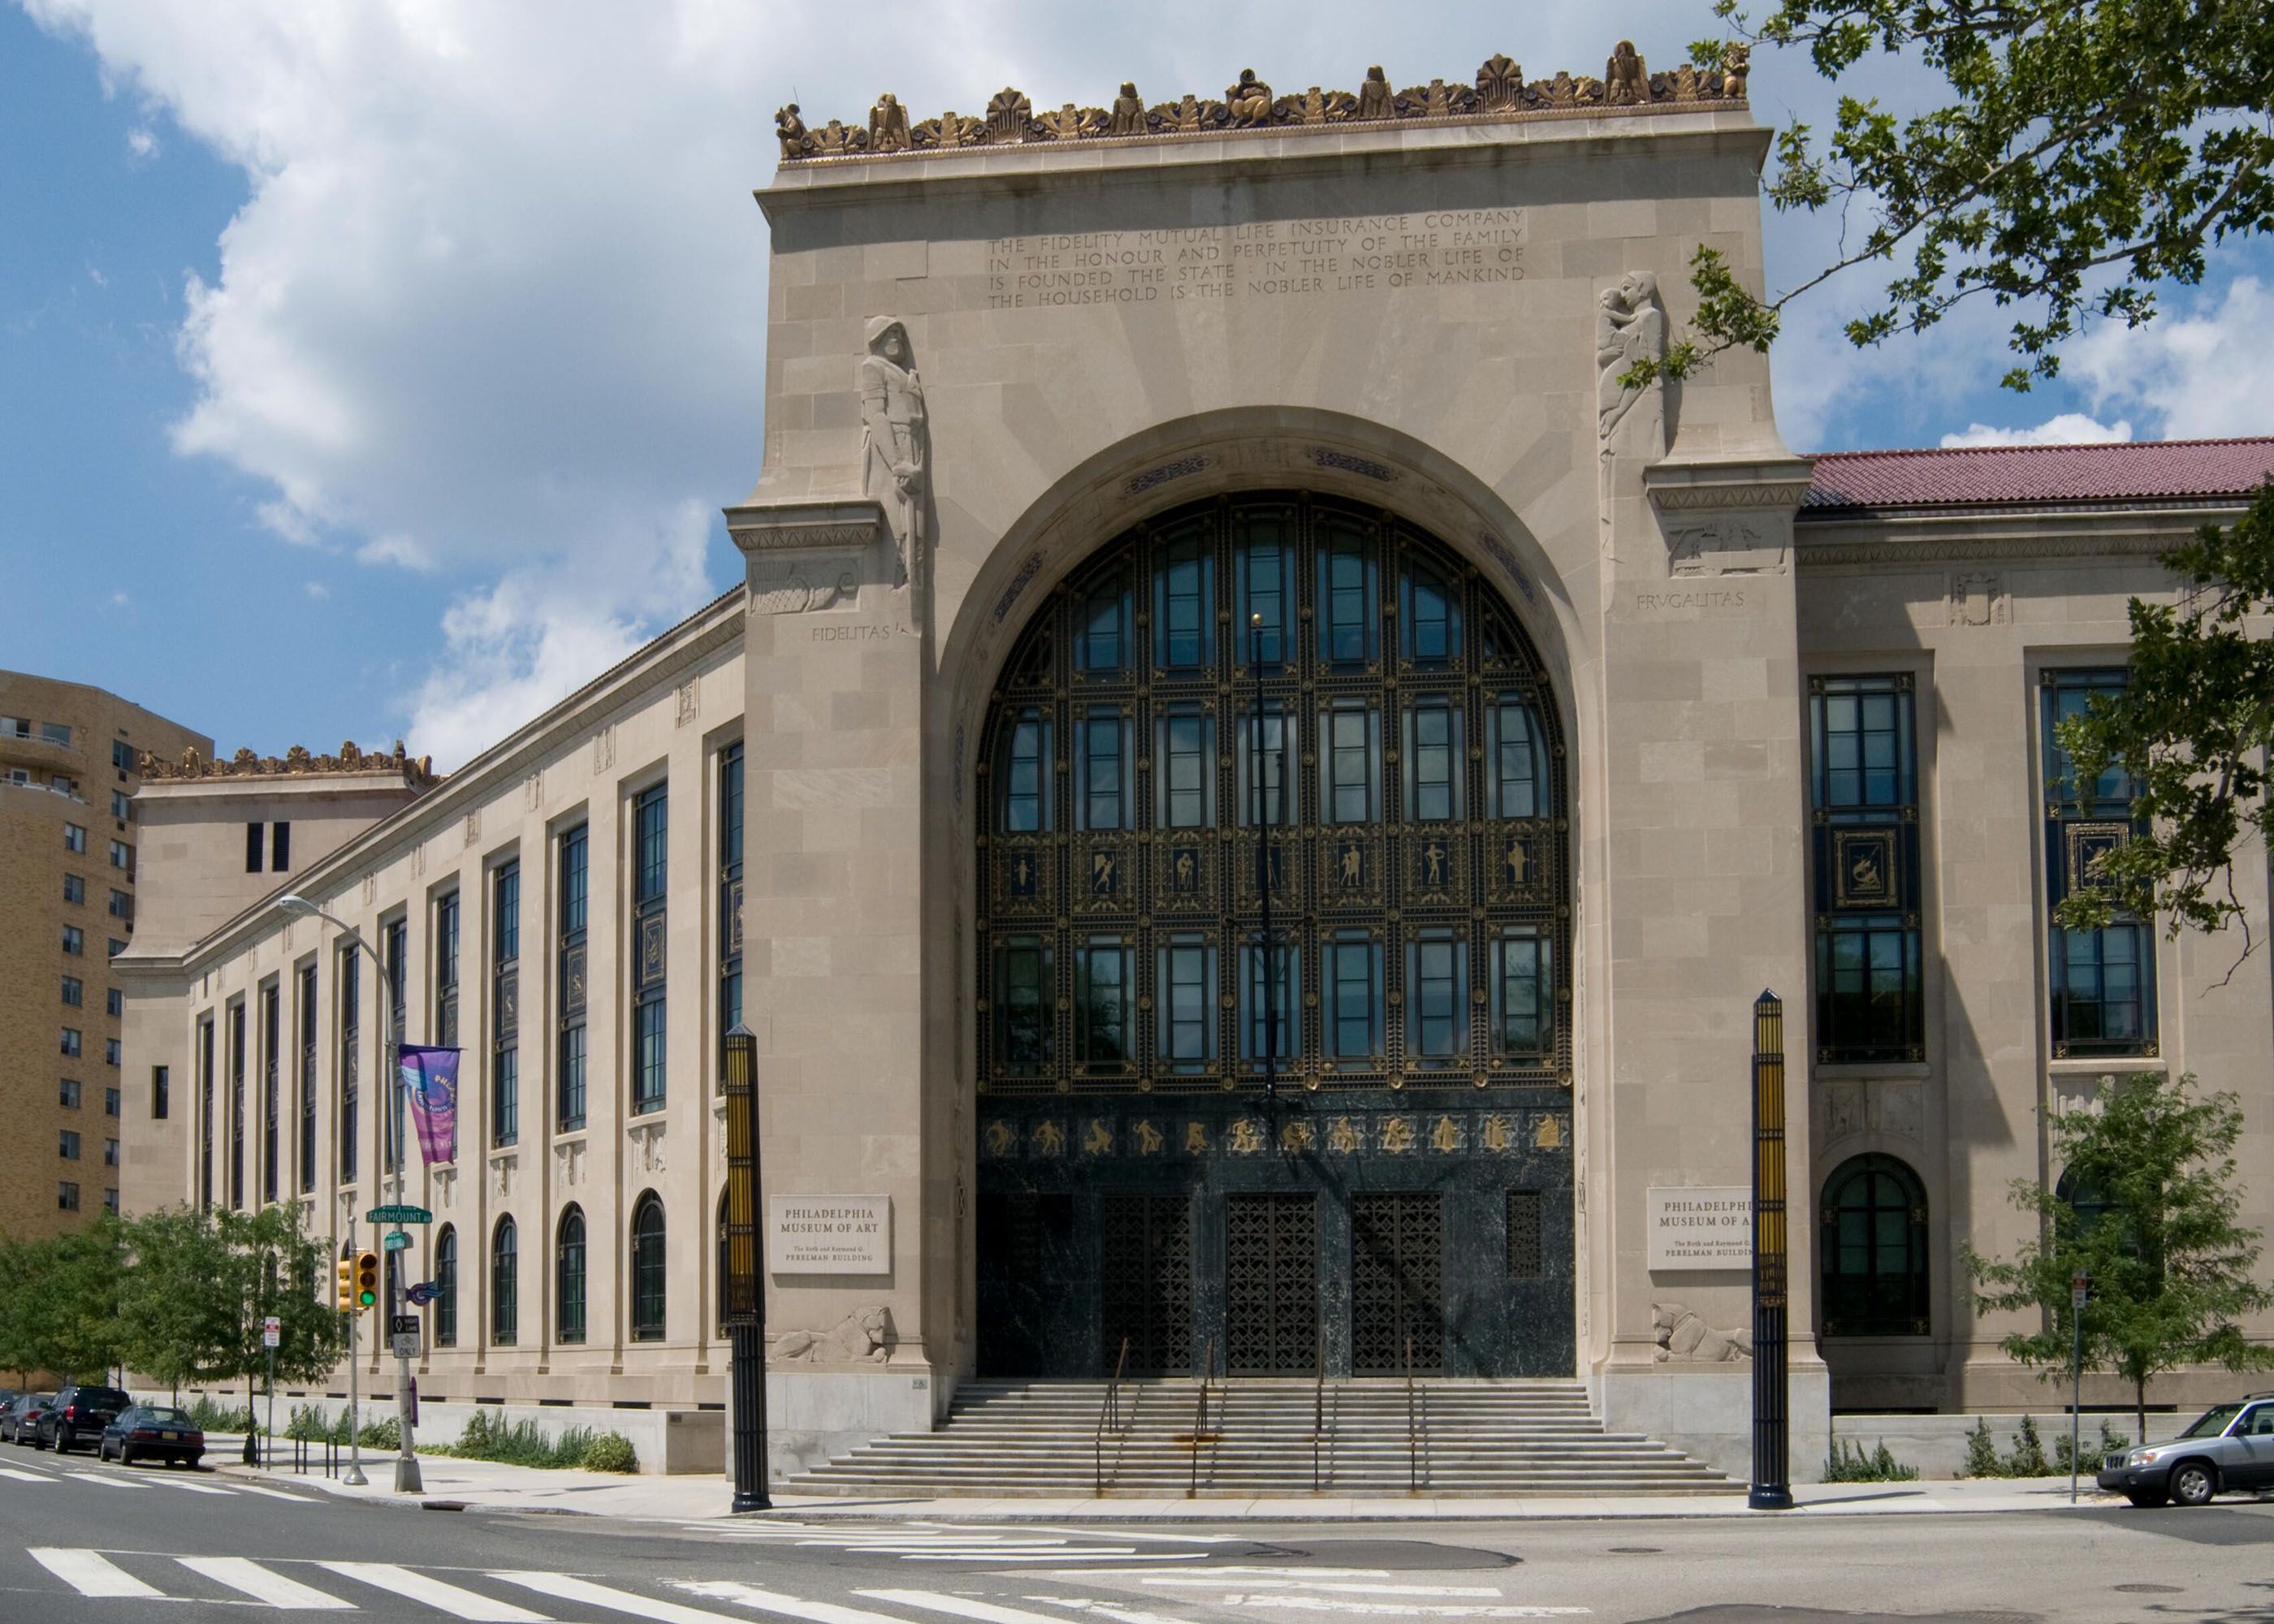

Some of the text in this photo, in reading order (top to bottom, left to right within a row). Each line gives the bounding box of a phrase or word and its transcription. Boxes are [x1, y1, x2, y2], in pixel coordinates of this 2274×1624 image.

[988, 209, 1524, 254] THE FIDELITY MUTUAL LIFE INSURANCE COMPANY
[989, 228, 1523, 271] IN THE HONOUR AND PERPETUITY OF THE FAMILY
[989, 276, 1005, 291] IS
[1018, 271, 1113, 289] FOUNDED
[1129, 268, 1165, 283] THE
[1178, 264, 1234, 280] STATE
[1266, 261, 1286, 274] IN
[1300, 258, 1338, 273] THE
[1352, 253, 1429, 270] NOBLER
[1445, 250, 1482, 266] LIFE
[1498, 248, 1524, 262] OF
[988, 267, 1524, 309] THE HOUSEHOLD IS THE NOBLER LIFE OF MANKIND
[1637, 591, 1744, 610] FRVGALITAS
[812, 625, 890, 641] FIDELITAS
[785, 1209, 874, 1218] PHILADELPHIA
[1664, 1202, 1752, 1212] PHILADELPHI
[369, 1212, 422, 1222] FAIRMOUNT
[1660, 1217, 1716, 1227] MUSEUM
[1722, 1216, 1737, 1226] OF
[781, 1223, 878, 1233] MUSEUM OF ART
